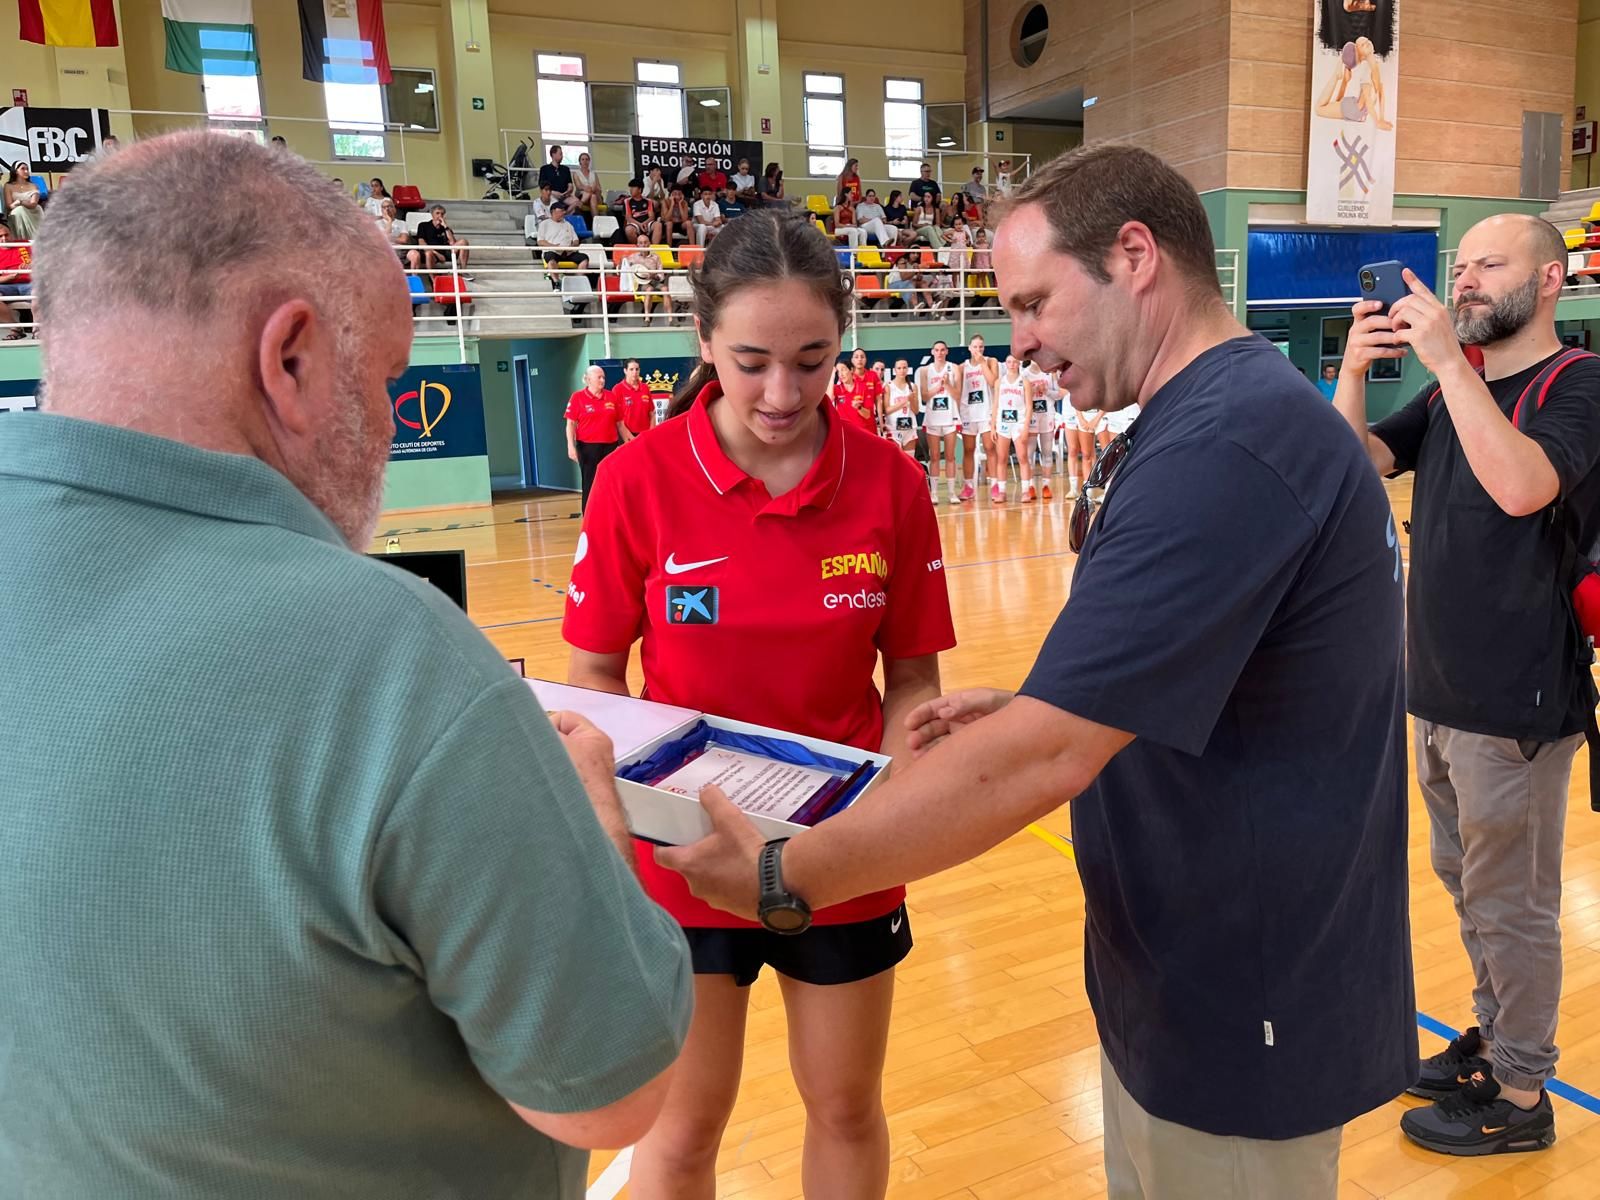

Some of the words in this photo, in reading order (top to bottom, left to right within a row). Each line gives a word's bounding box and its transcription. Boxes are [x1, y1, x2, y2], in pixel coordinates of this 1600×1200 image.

[641, 139, 732, 156] FEDERACIÓN
[641, 154, 732, 170] BALOCETO
[821, 551, 888, 581] ESPAÑA
